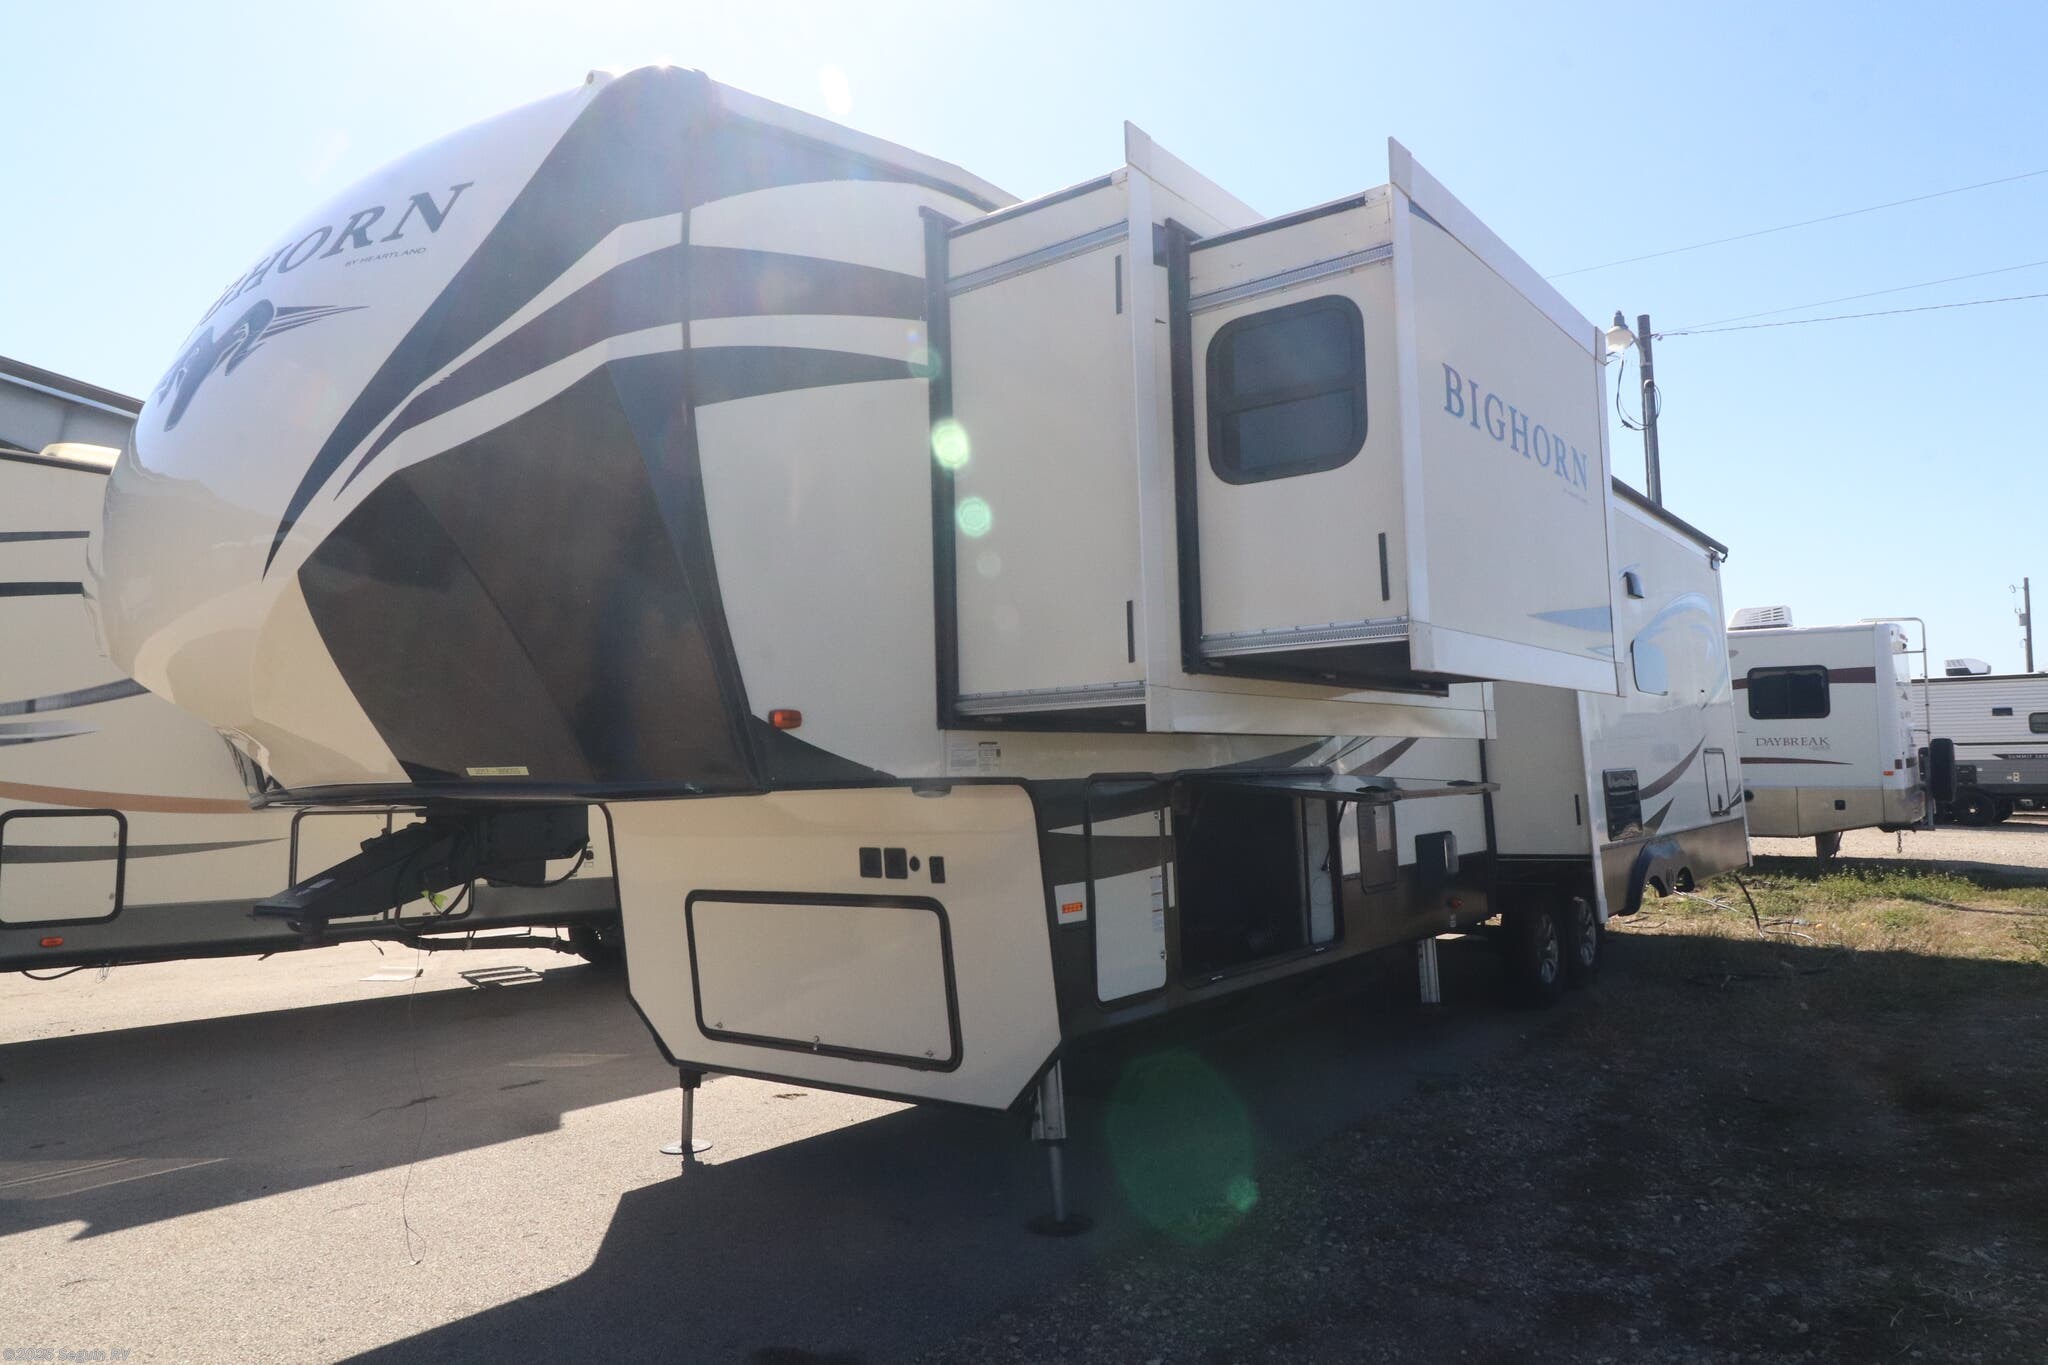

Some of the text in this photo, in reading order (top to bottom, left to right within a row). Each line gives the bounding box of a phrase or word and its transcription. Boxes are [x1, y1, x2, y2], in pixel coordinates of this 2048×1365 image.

[359, 247, 427, 262] HEARTLAND
[1442, 363, 1587, 491] BIGHORN
[1755, 737, 1830, 747] DAYBREAK
